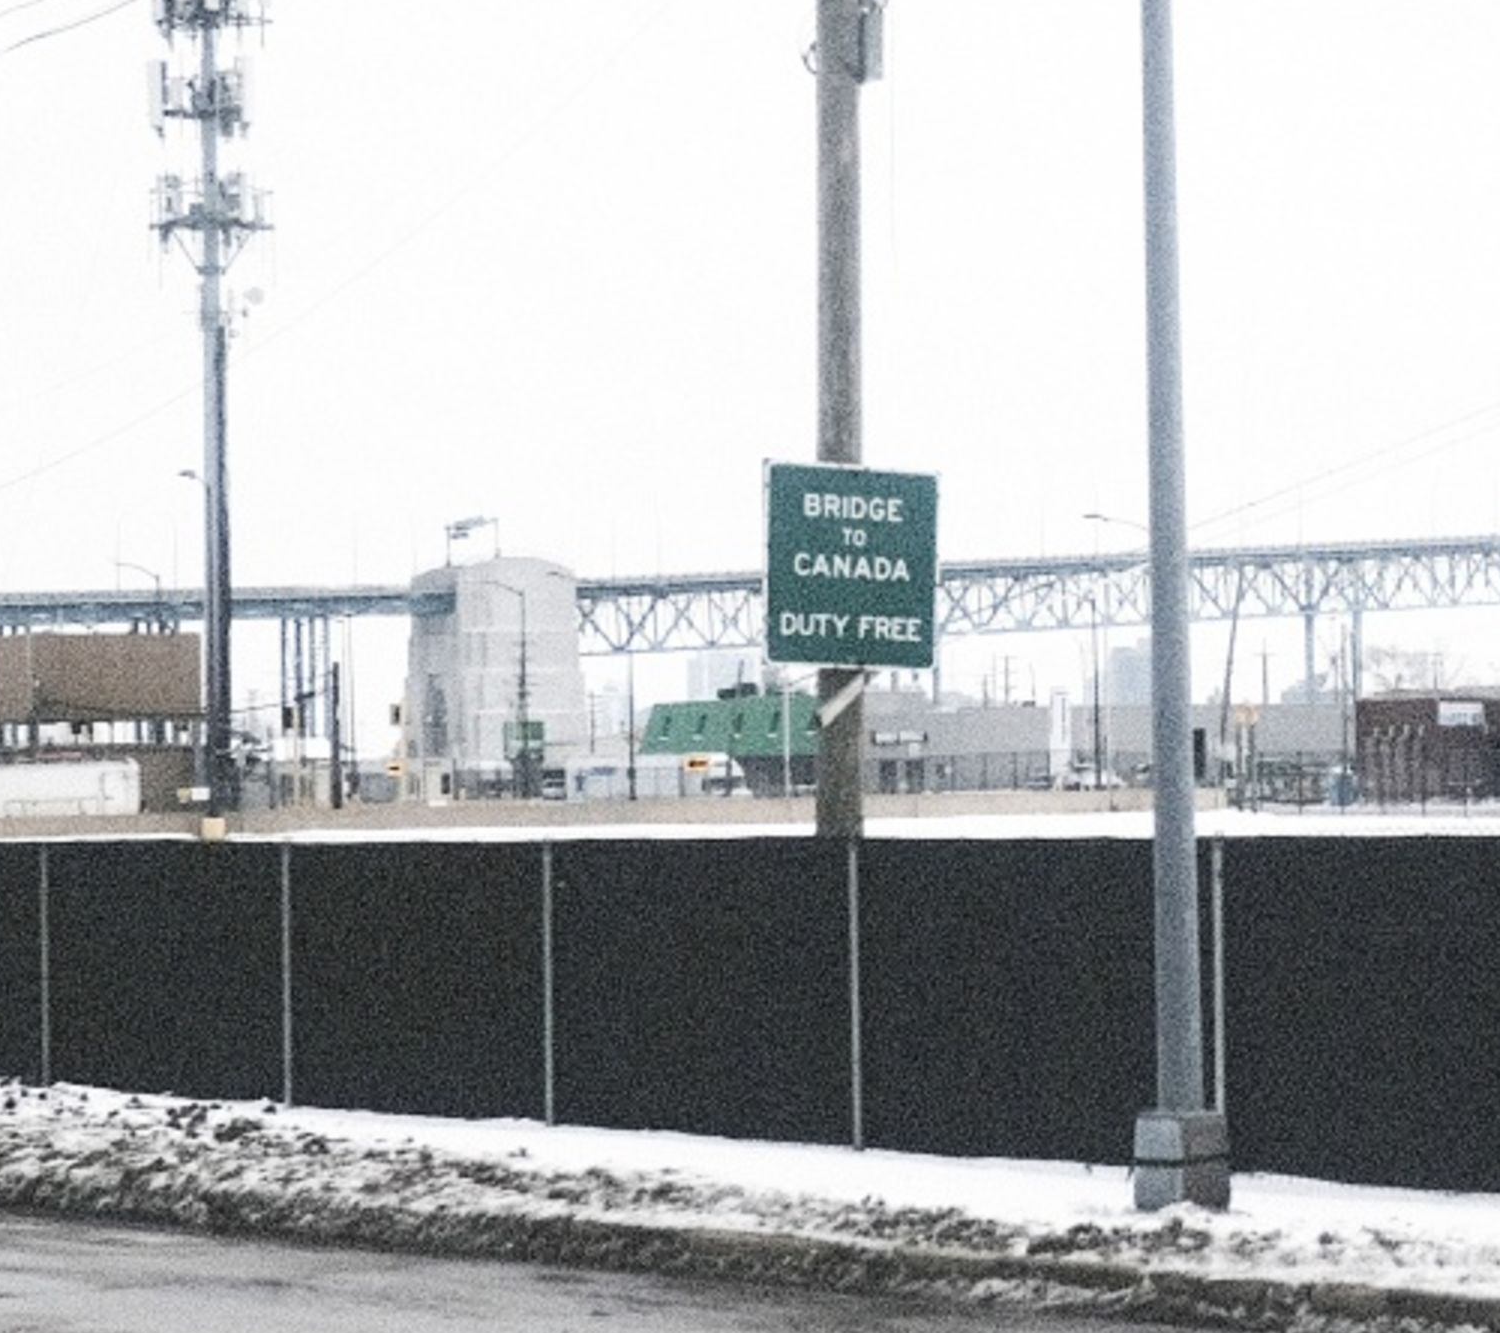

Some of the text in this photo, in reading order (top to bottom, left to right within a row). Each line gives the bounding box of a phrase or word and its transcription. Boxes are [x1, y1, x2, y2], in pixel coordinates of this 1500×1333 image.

[802, 492, 904, 523] BRIDGE
[841, 527, 868, 548] TO
[793, 552, 911, 582] CANADA
[779, 611, 922, 643] DUTY FREE
